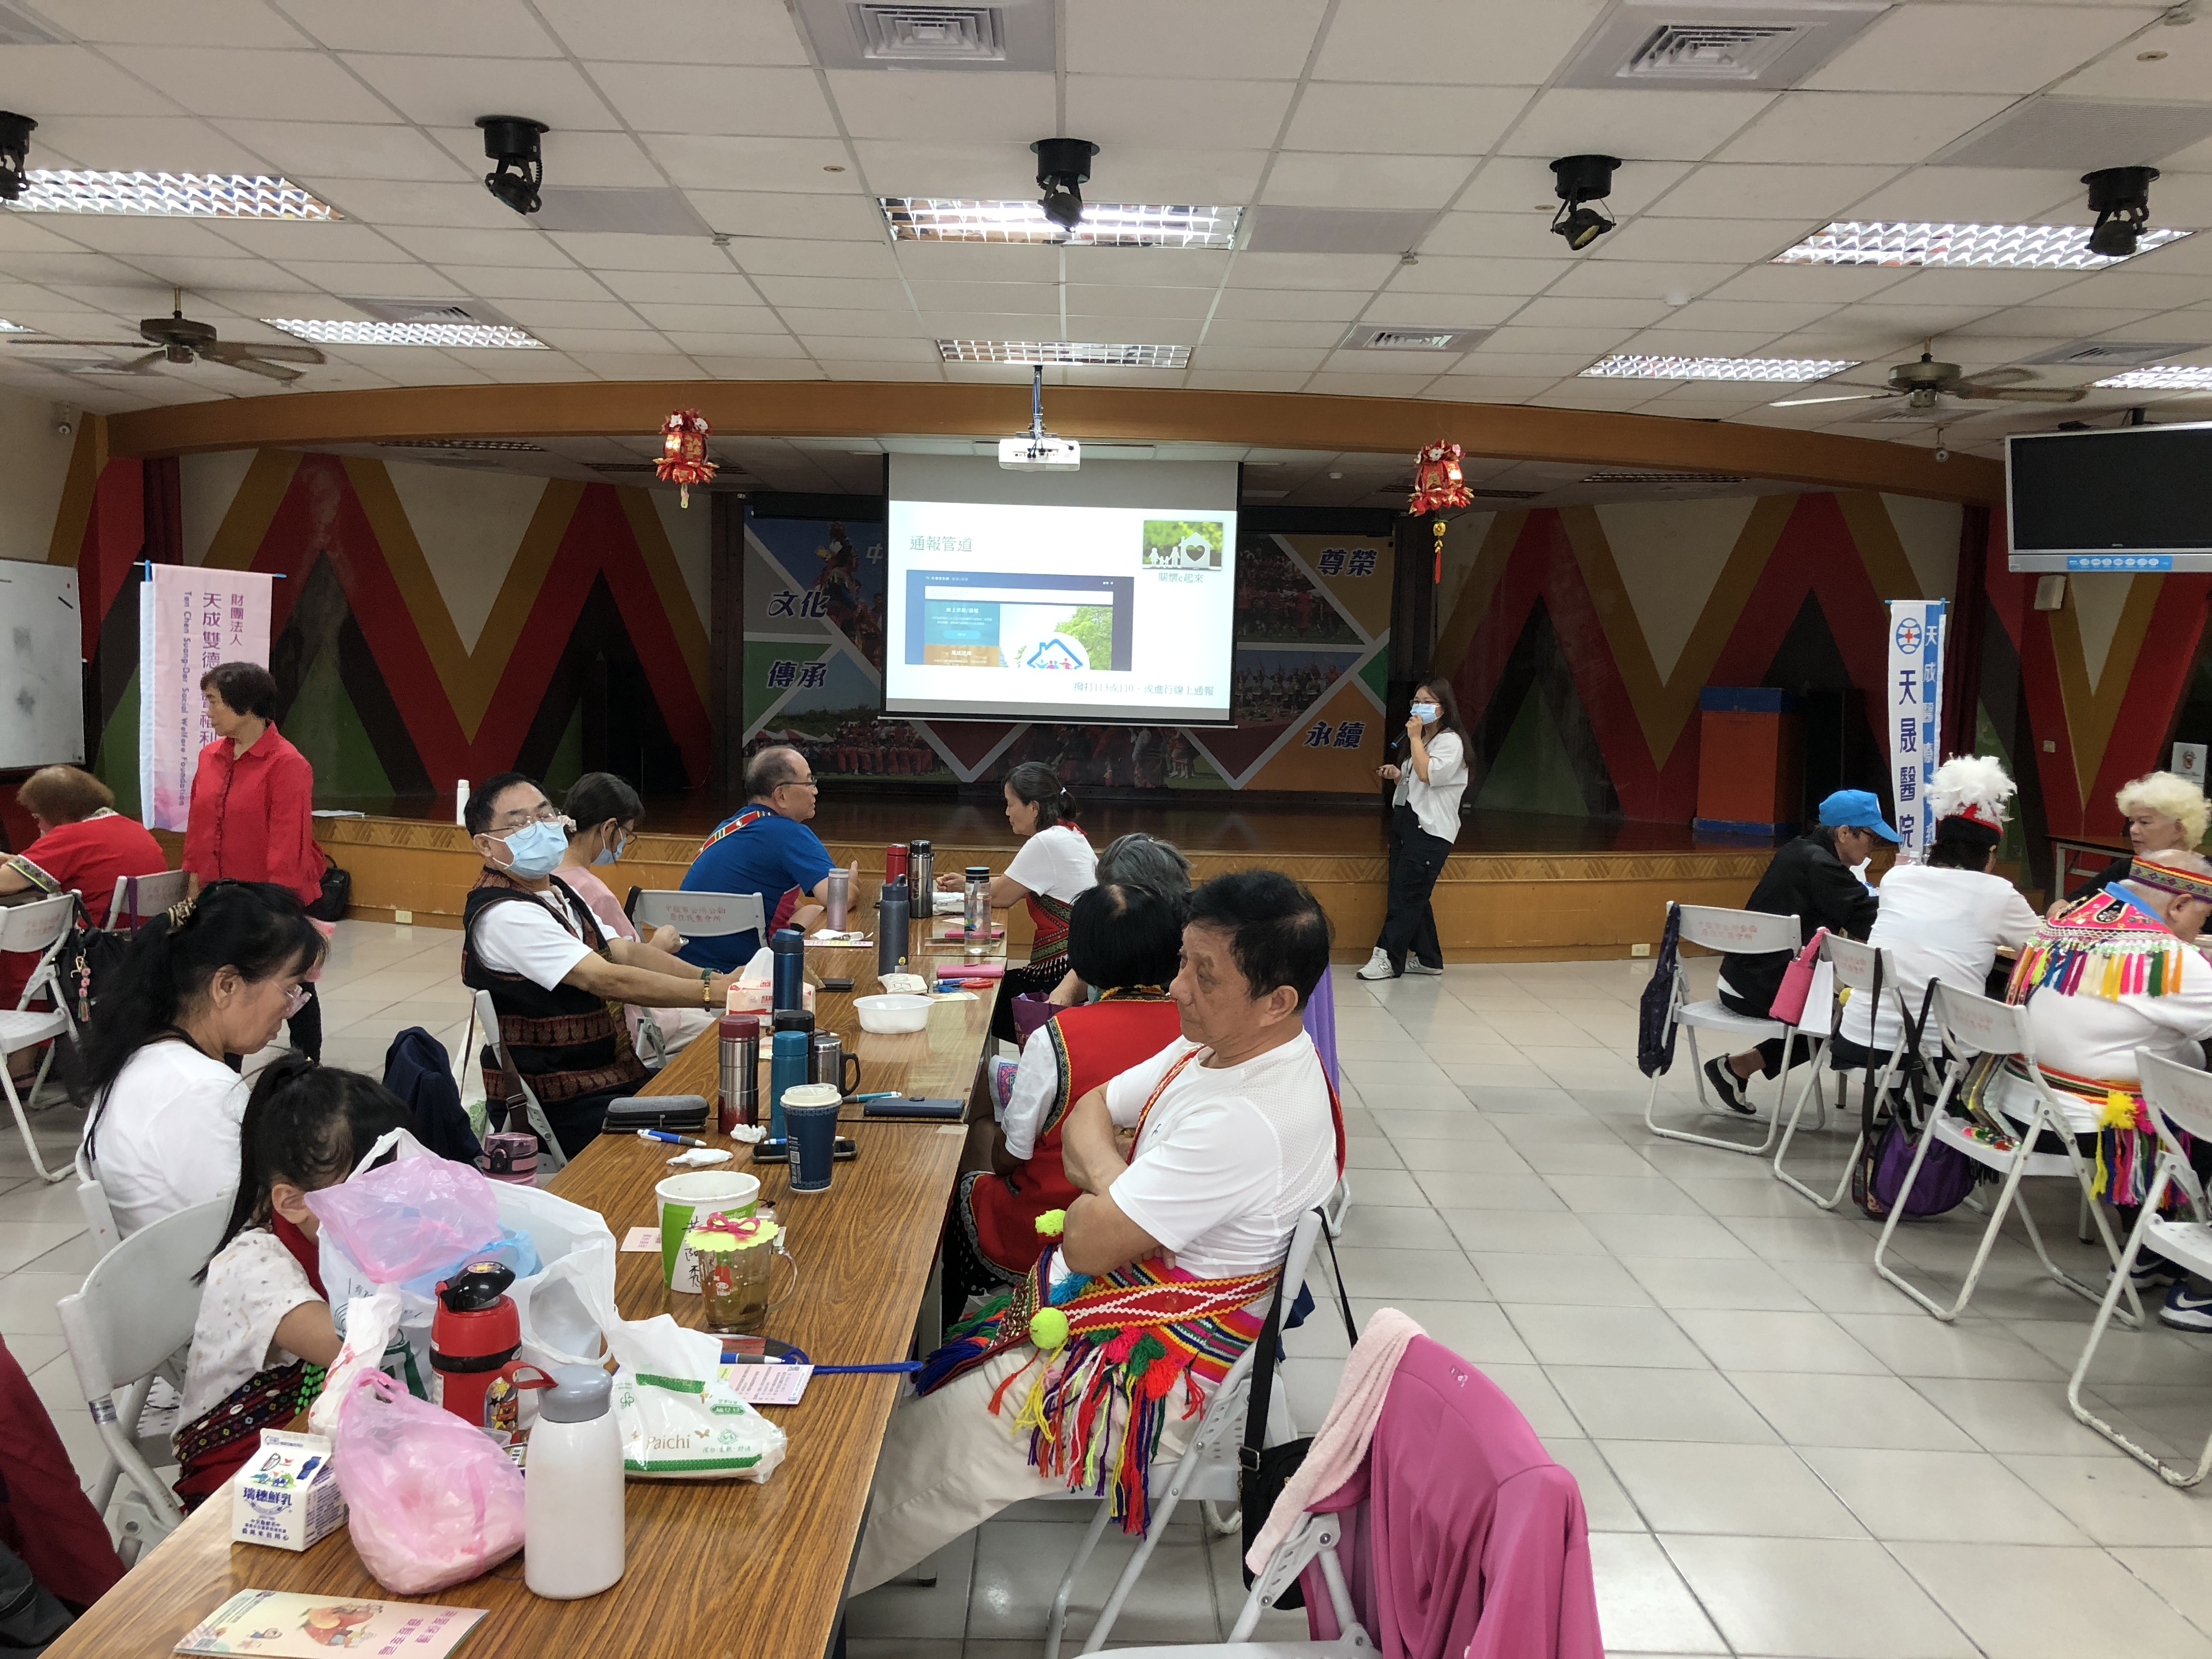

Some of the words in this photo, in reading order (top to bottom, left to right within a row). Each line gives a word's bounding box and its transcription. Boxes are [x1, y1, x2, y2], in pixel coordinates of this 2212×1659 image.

[910, 535, 972, 552] 通報管道
[1318, 549, 1378, 577] 尊榮
[768, 590, 830, 618] 文化
[183, 611, 192, 634] Chen
[230, 594, 244, 646] 財團法人
[768, 662, 827, 688] 傳承
[1303, 721, 1365, 748] 永續
[1899, 670, 1917, 849] 天晟醫院
[179, 757, 188, 805] Foundation
[646, 1434, 691, 1450] Paichi
[243, 1487, 292, 1506] 瑞穗鮮乳
